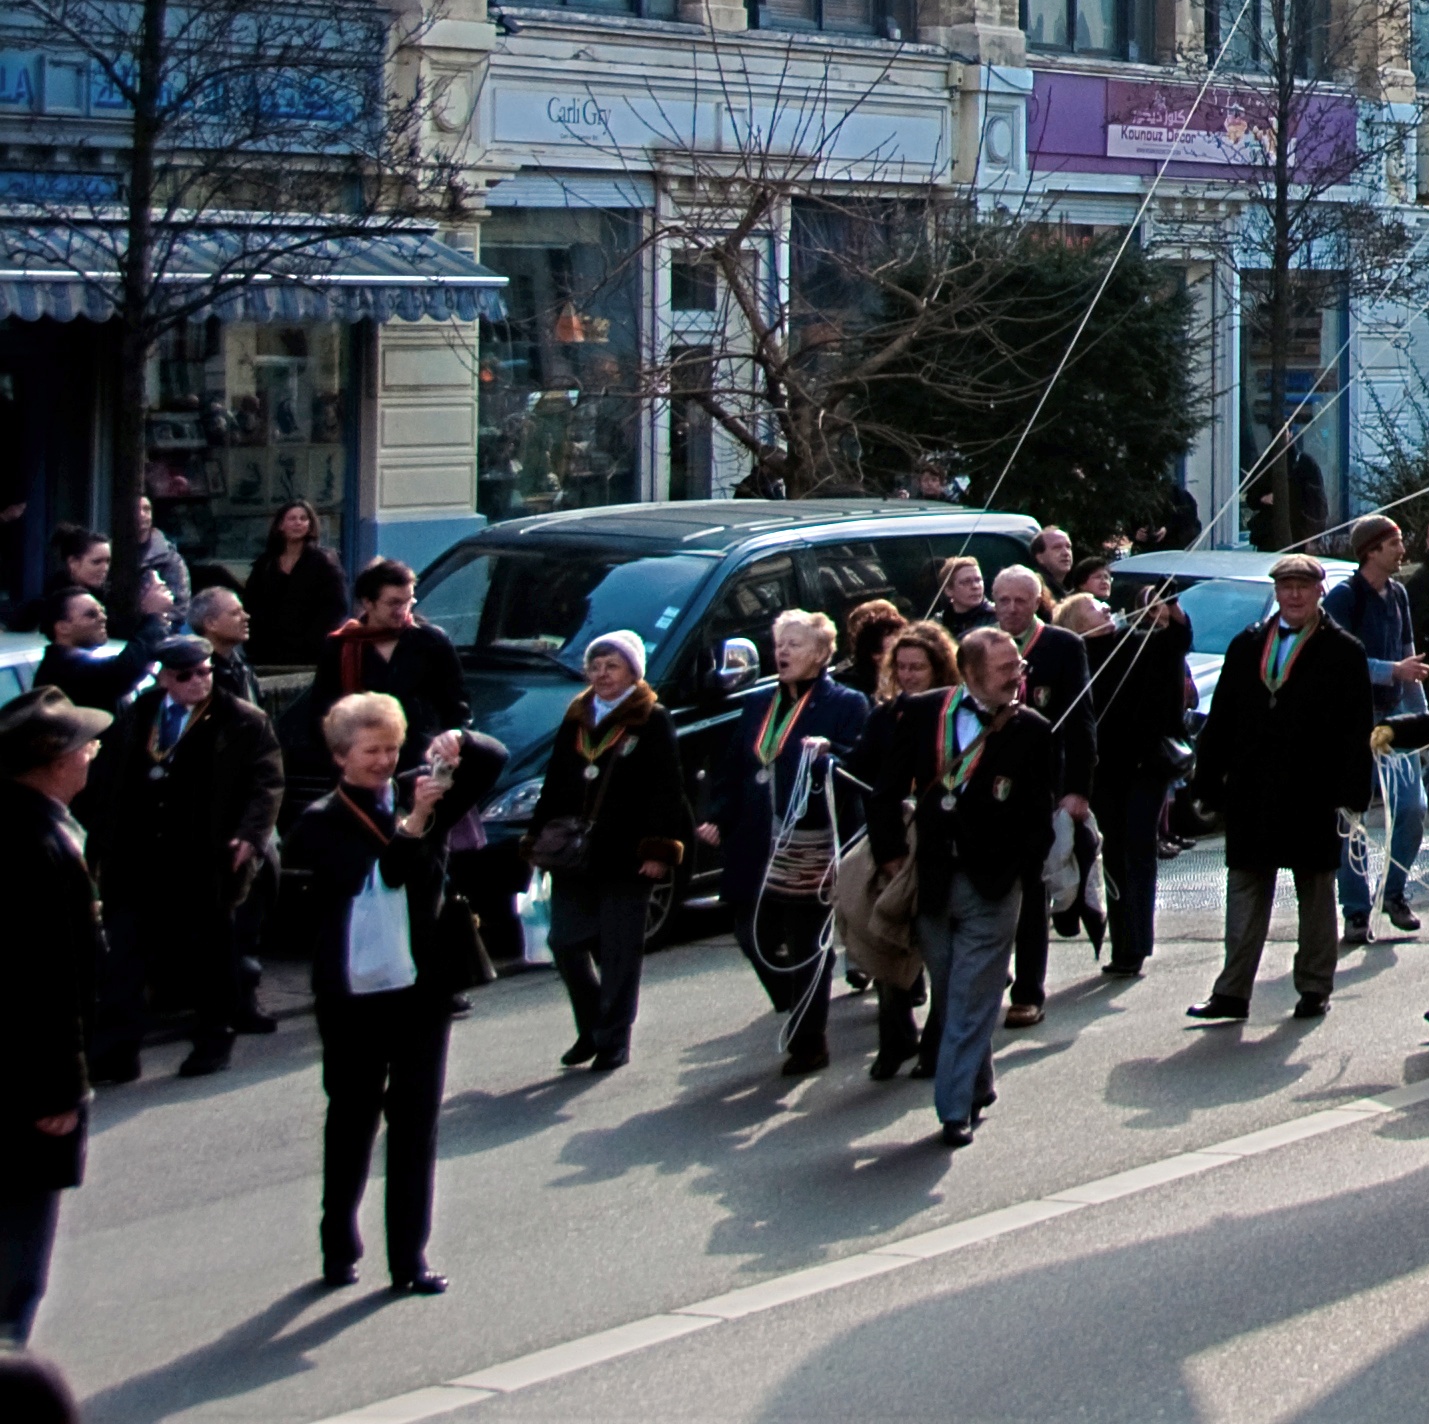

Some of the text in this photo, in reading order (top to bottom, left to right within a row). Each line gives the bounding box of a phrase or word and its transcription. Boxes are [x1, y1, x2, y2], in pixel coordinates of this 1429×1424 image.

[547, 96, 612, 136] Carli Gry
[1121, 125, 1164, 143] Kounouz
